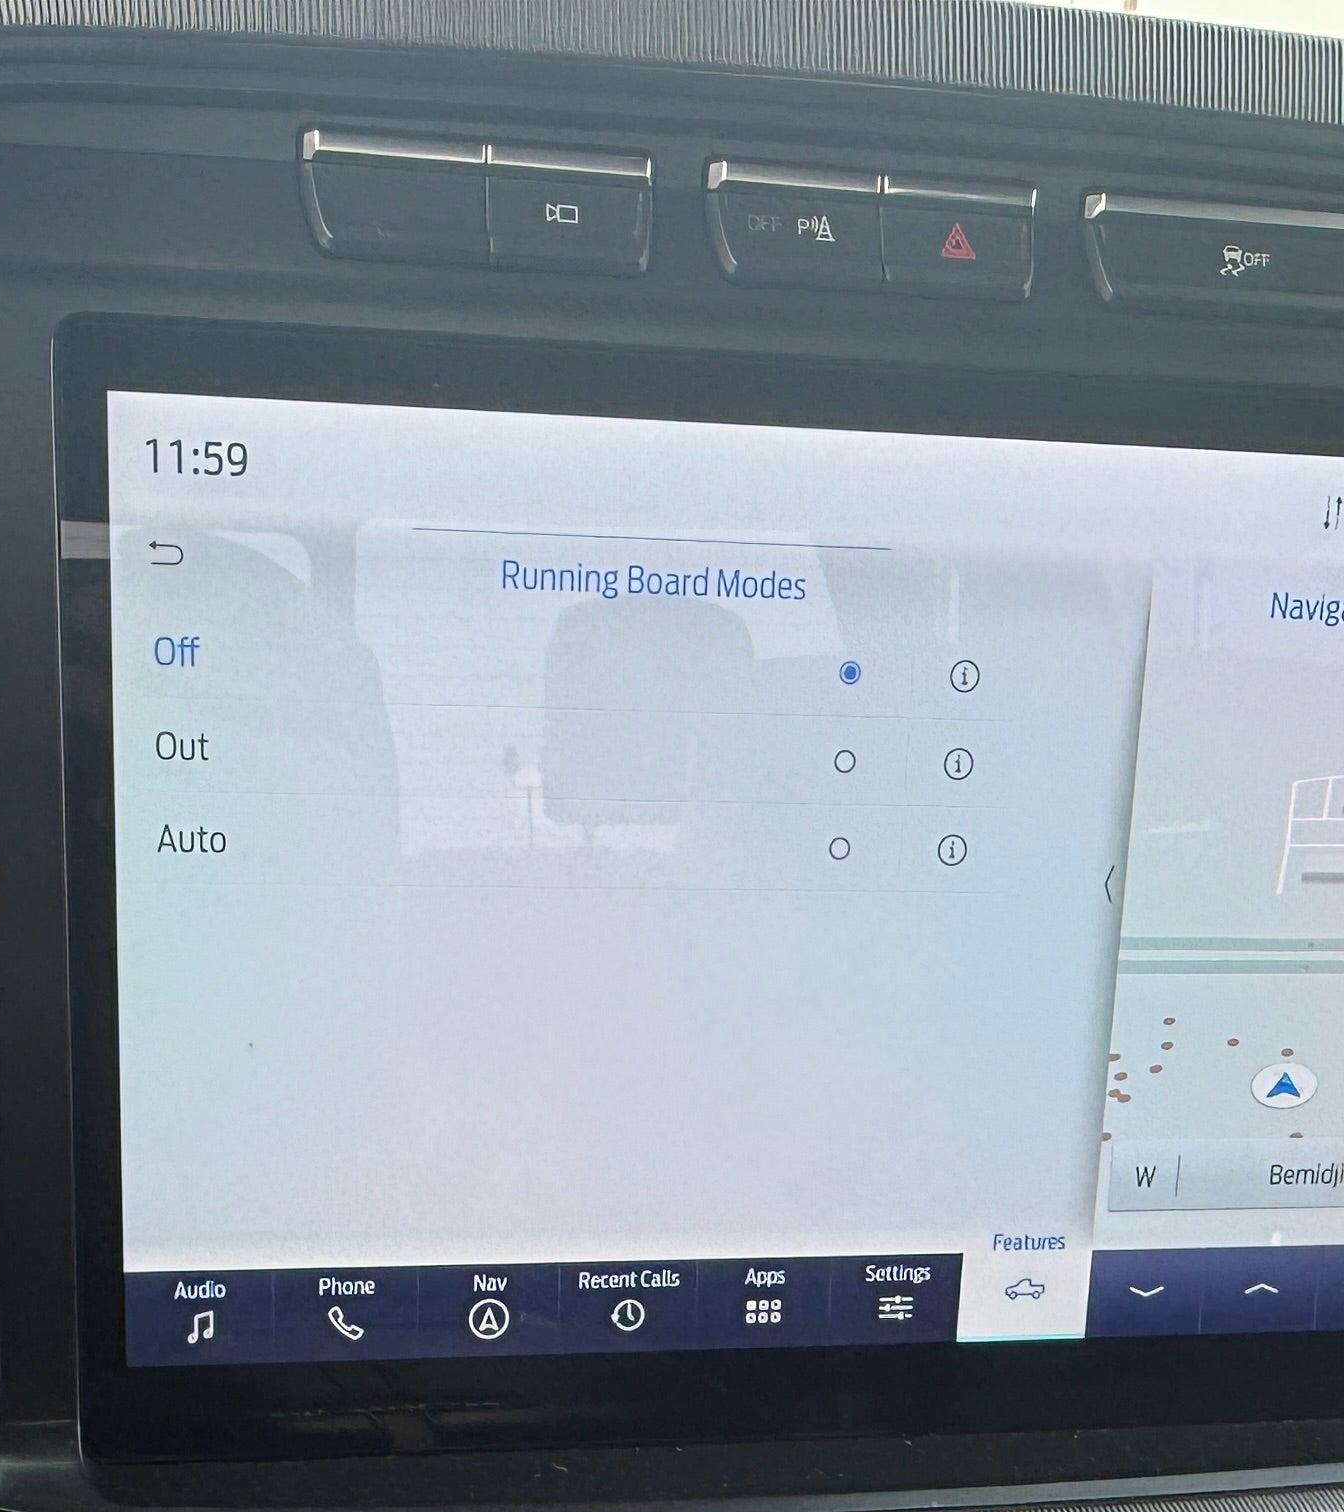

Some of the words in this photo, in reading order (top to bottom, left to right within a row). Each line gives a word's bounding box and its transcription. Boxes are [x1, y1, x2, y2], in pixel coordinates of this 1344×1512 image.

[1243, 252, 1270, 267] OFF
[145, 438, 249, 477] 11:59
[501, 560, 619, 598] Running
[627, 565, 709, 597] Board
[716, 570, 807, 600] Modes
[154, 636, 200, 667] Off
[155, 731, 209, 762] Out
[157, 825, 227, 854] Auto
[1136, 1165, 1157, 1188] W
[1270, 1163, 1344, 1188] Bemidji
[992, 1234, 1066, 1251] Features
[473, 1274, 508, 1292] Nav
[578, 1271, 638, 1290] Recent
[640, 1269, 681, 1288] Calls
[744, 1267, 786, 1287] Apps
[865, 1263, 931, 1284] Settings
[174, 1280, 227, 1300] Audio
[318, 1277, 376, 1296] Phone
